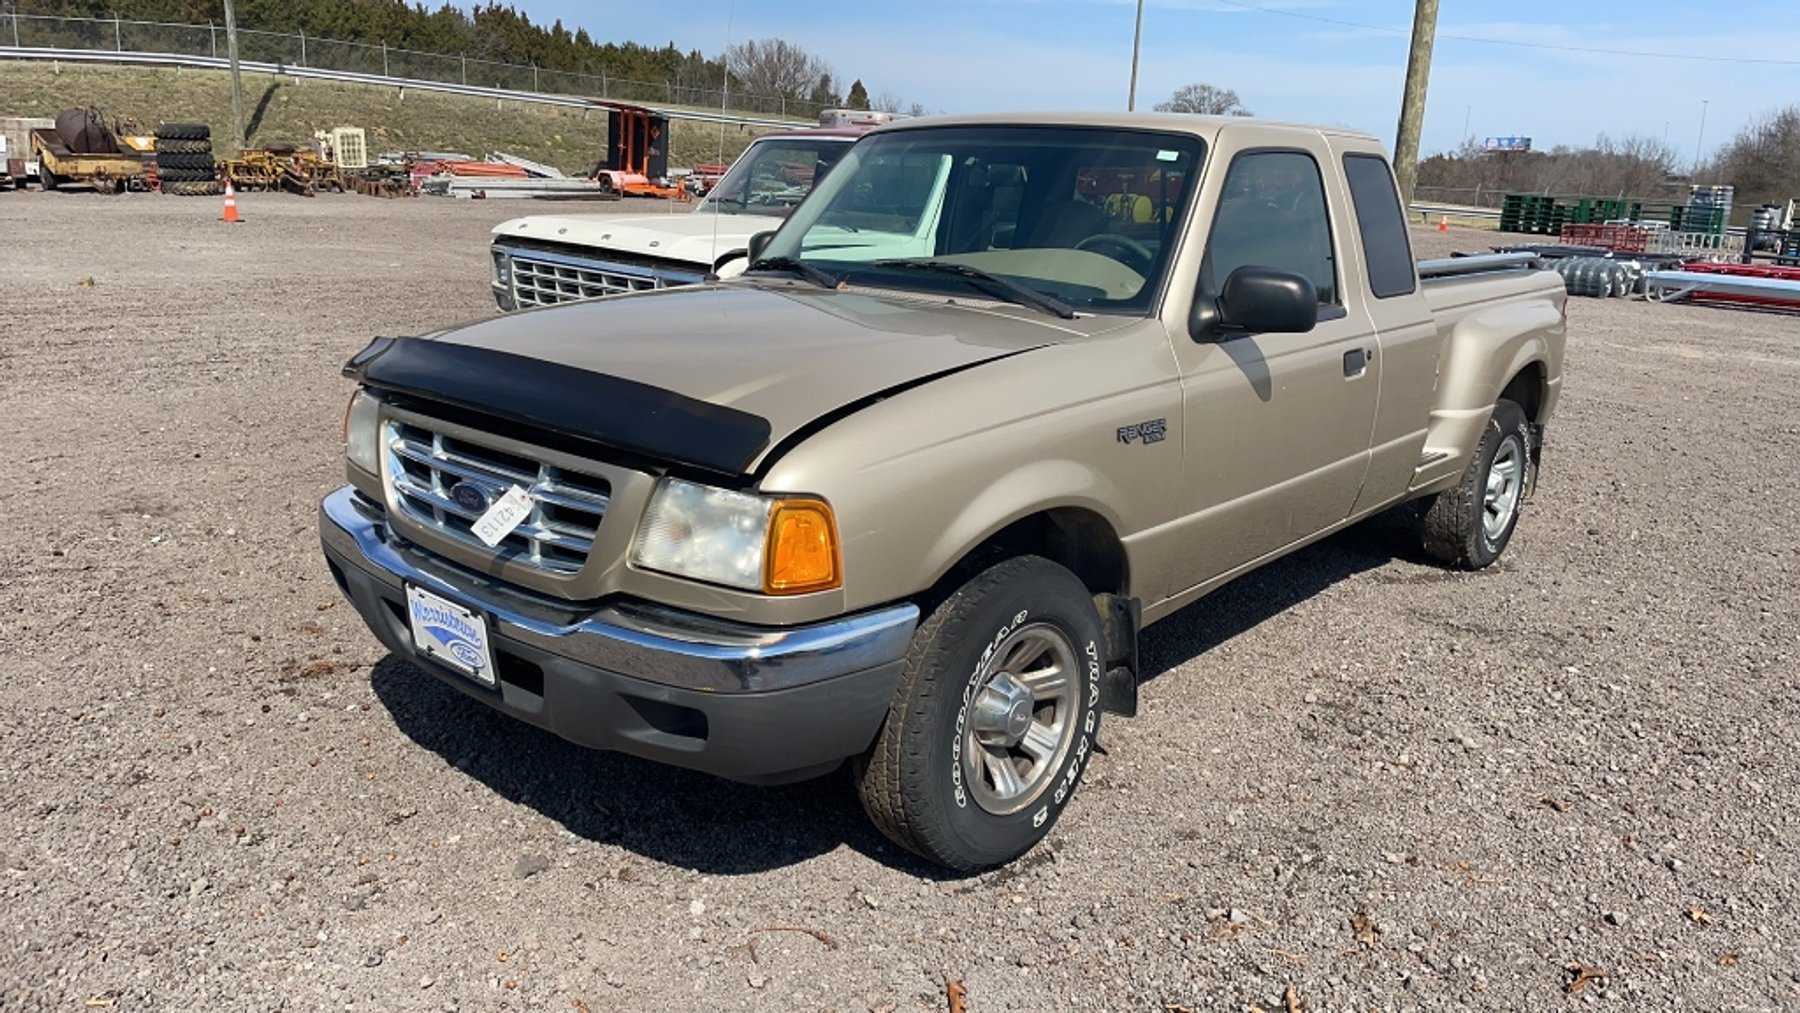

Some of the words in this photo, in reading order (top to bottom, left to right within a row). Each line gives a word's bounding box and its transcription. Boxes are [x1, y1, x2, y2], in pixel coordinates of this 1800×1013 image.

[518, 223, 661, 247] FORD
[1116, 418, 1167, 444] RANGER
[481, 506, 515, 538] 42113
[953, 609, 1028, 808] GOODYEAR
